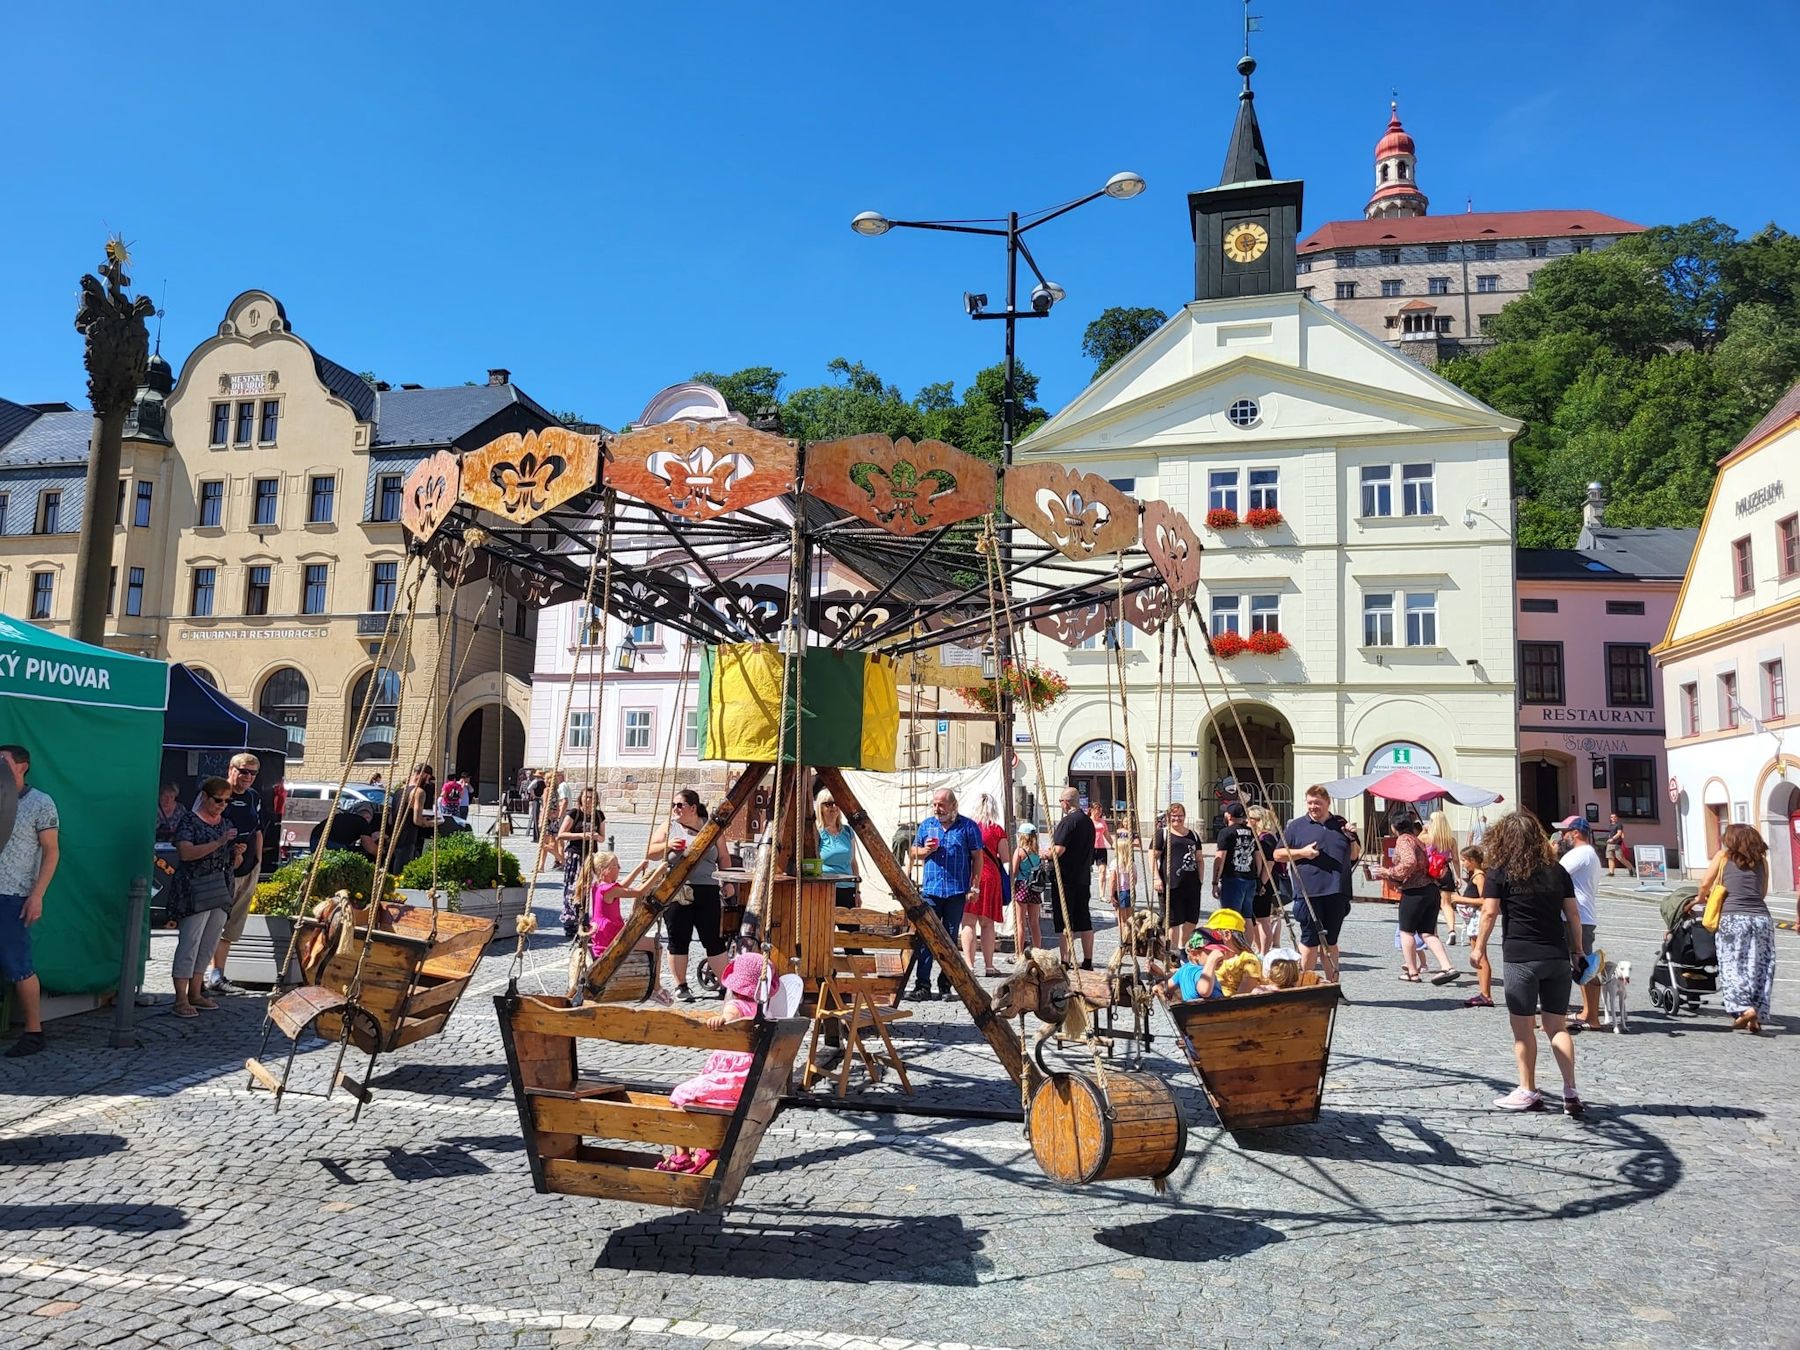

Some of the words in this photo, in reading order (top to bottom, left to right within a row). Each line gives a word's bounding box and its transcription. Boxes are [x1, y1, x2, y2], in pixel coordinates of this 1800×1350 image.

[1735, 479, 1783, 517] MUZEUM
[25, 657, 111, 690] PIVOVAR
[1542, 708, 1656, 723] RESTAURANT
